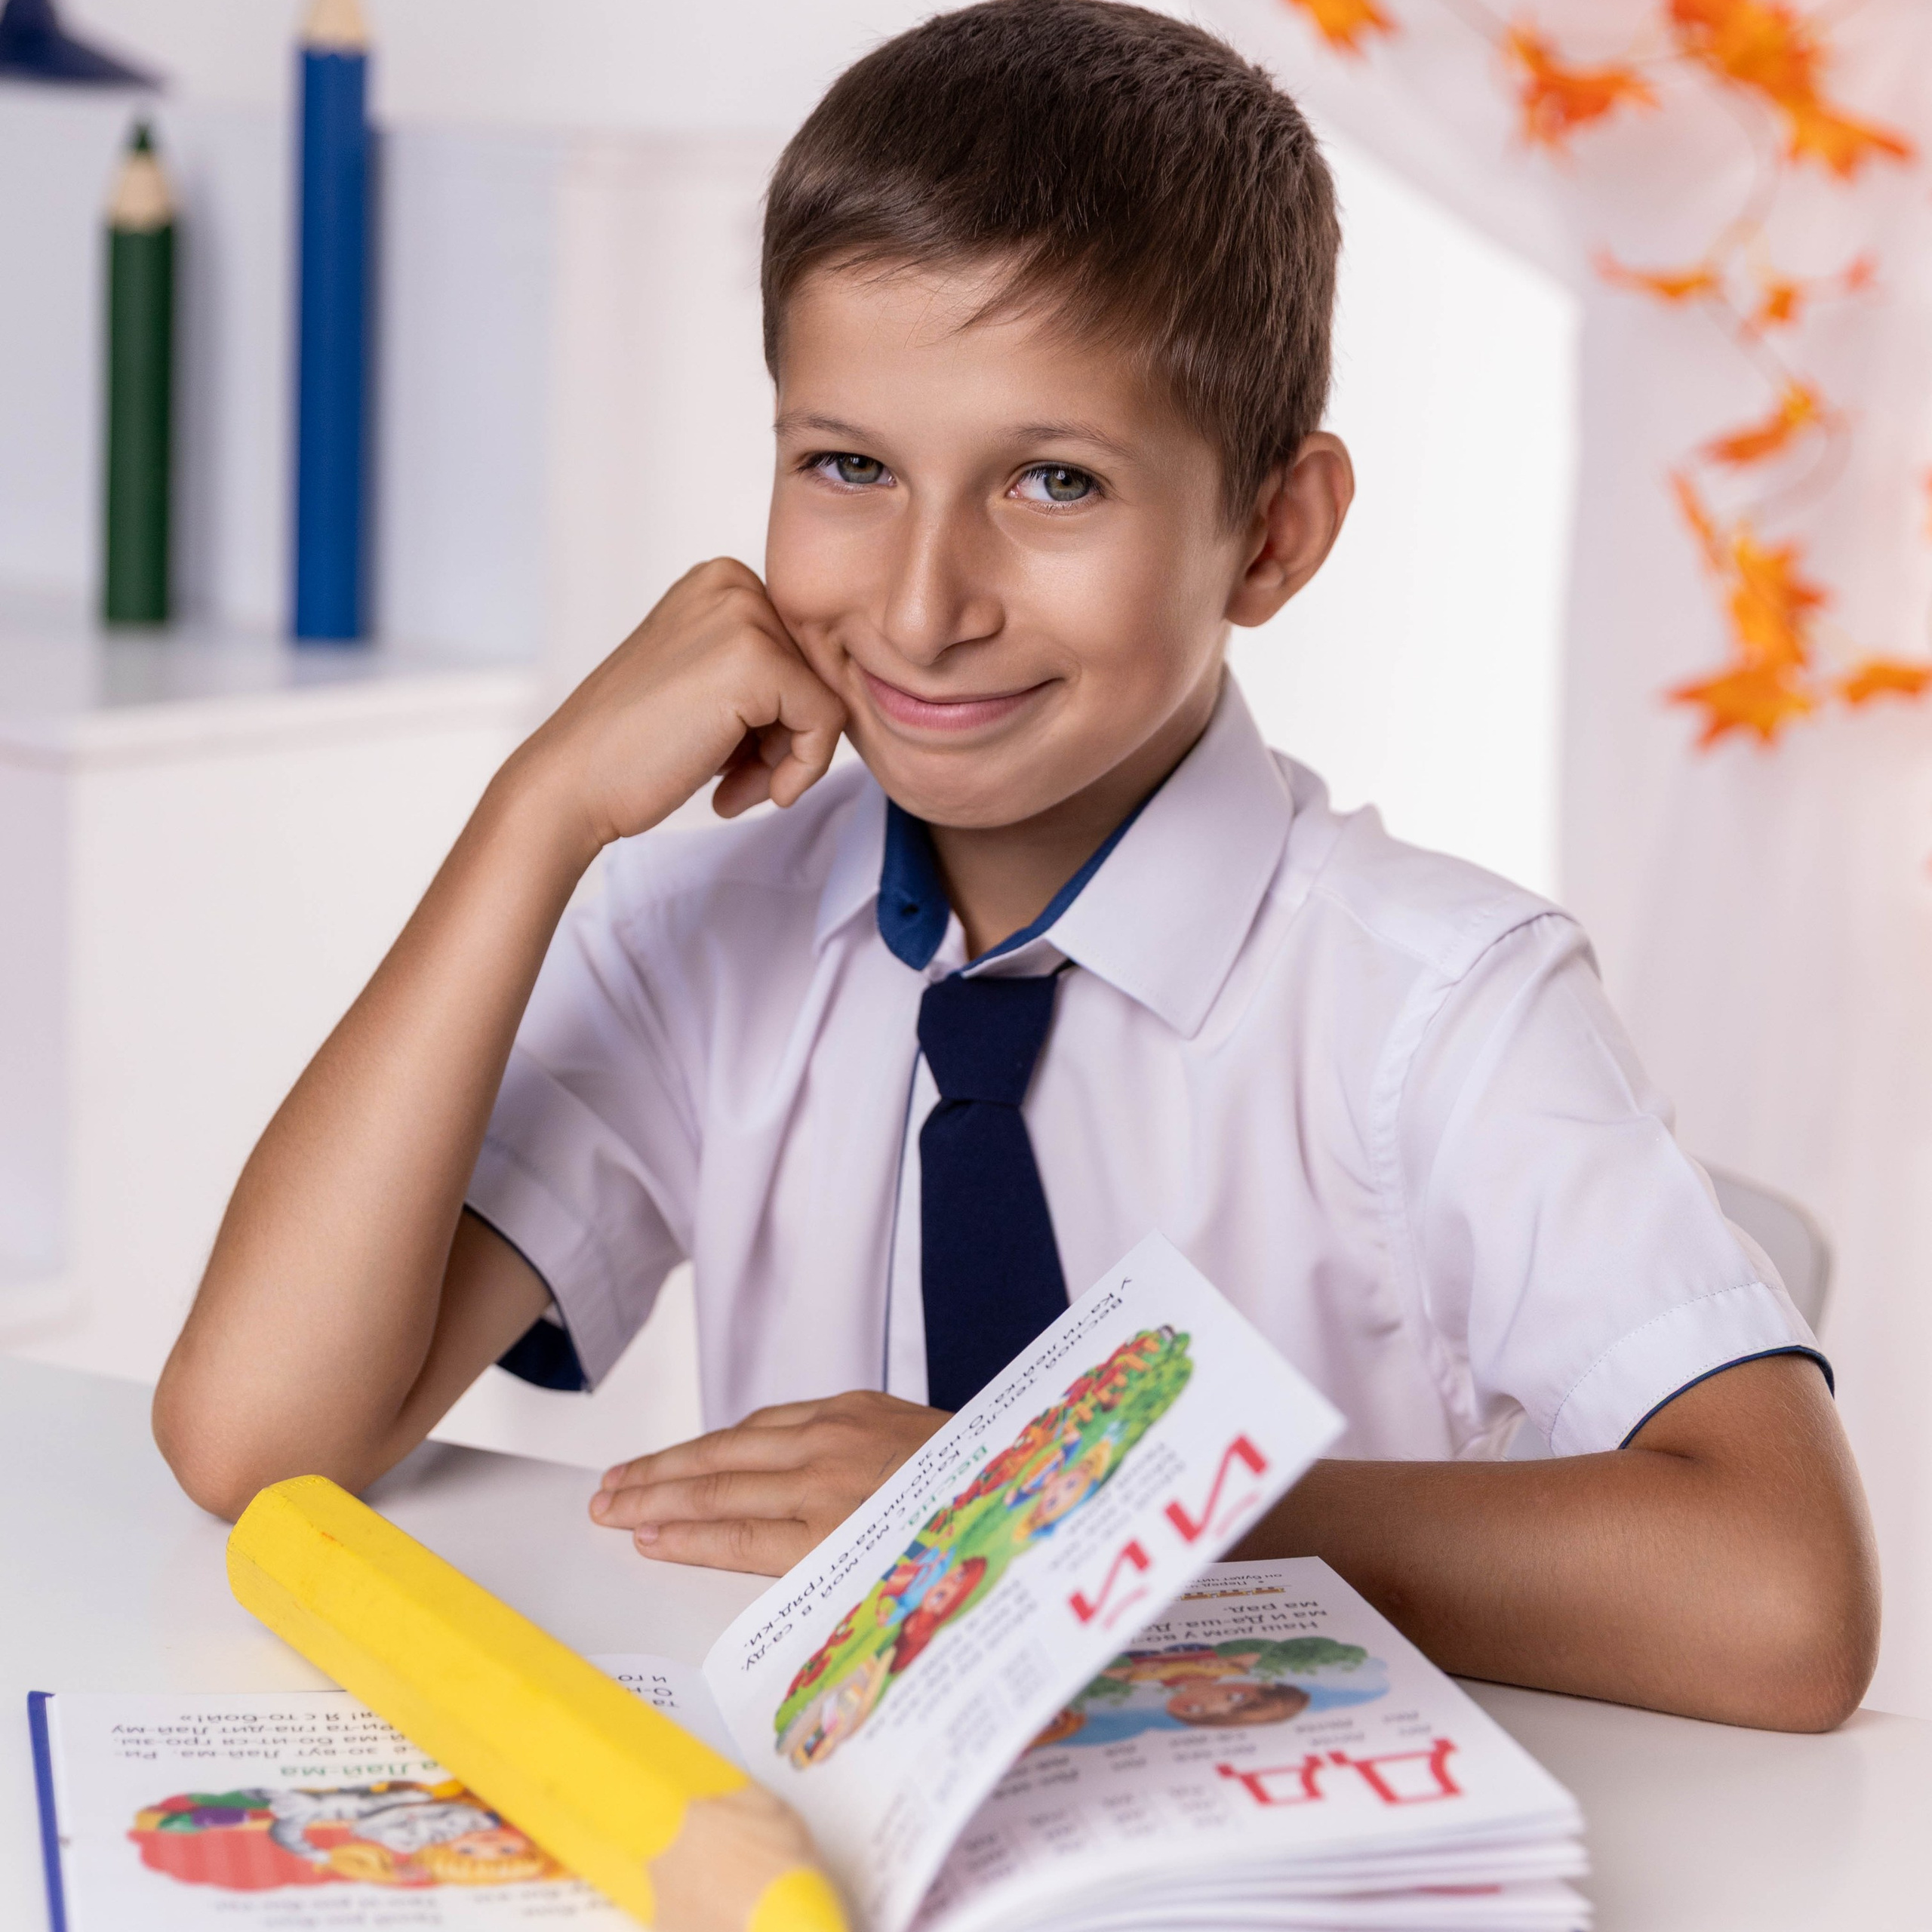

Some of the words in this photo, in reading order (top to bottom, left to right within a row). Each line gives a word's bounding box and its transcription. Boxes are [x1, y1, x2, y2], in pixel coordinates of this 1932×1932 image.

[1044, 1297, 1123, 1370] Вес-ной
[1063, 1292, 1115, 1340] Ка-ти
[989, 1343, 1057, 1407] лей-ка.
[938, 1414, 984, 1457] О-на
[968, 1378, 1035, 1441] теп-ло.
[913, 1449, 961, 1499] Ка-тя
[827, 1461, 934, 1574] по-ли-ва-ет
[820, 1524, 890, 1598] ма-мой
[744, 1576, 824, 1647] гряд-ки.
[741, 1623, 793, 1672] са-ду.
